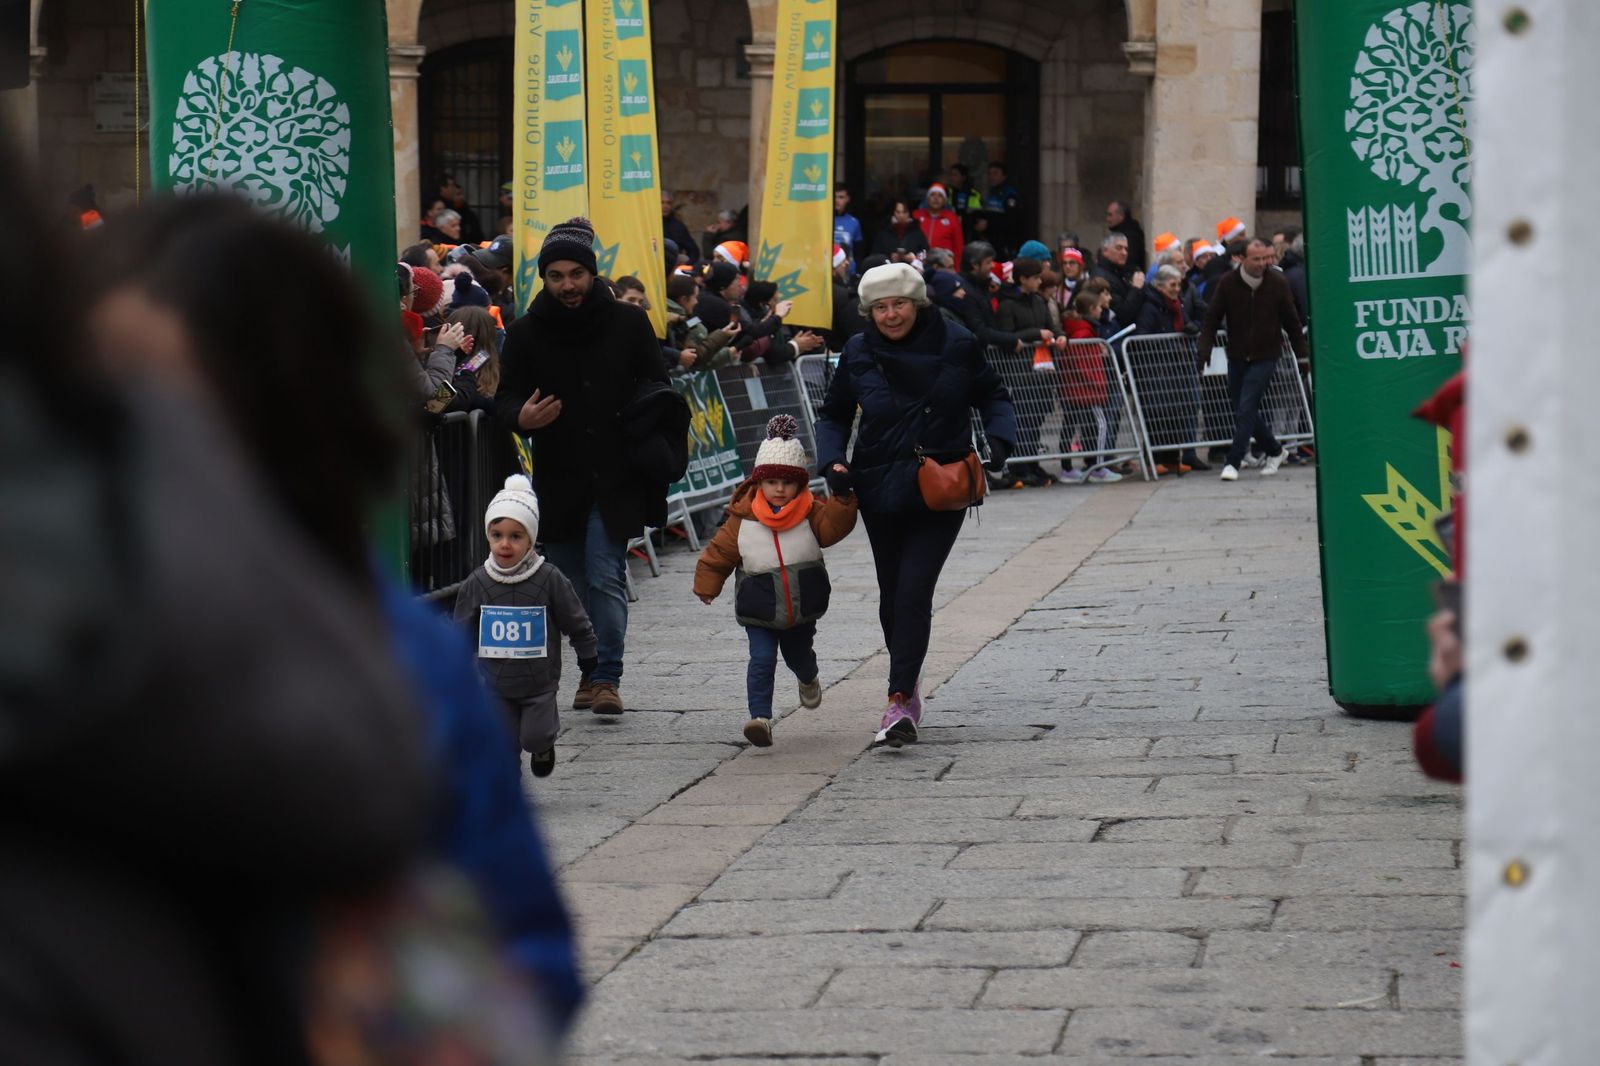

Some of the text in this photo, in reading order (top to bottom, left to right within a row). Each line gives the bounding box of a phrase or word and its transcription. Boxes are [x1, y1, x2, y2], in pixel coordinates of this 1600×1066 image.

[1354, 294, 1470, 328] FUNDA
[1356, 326, 1472, 360] CAJA R
[491, 620, 531, 641] 081
